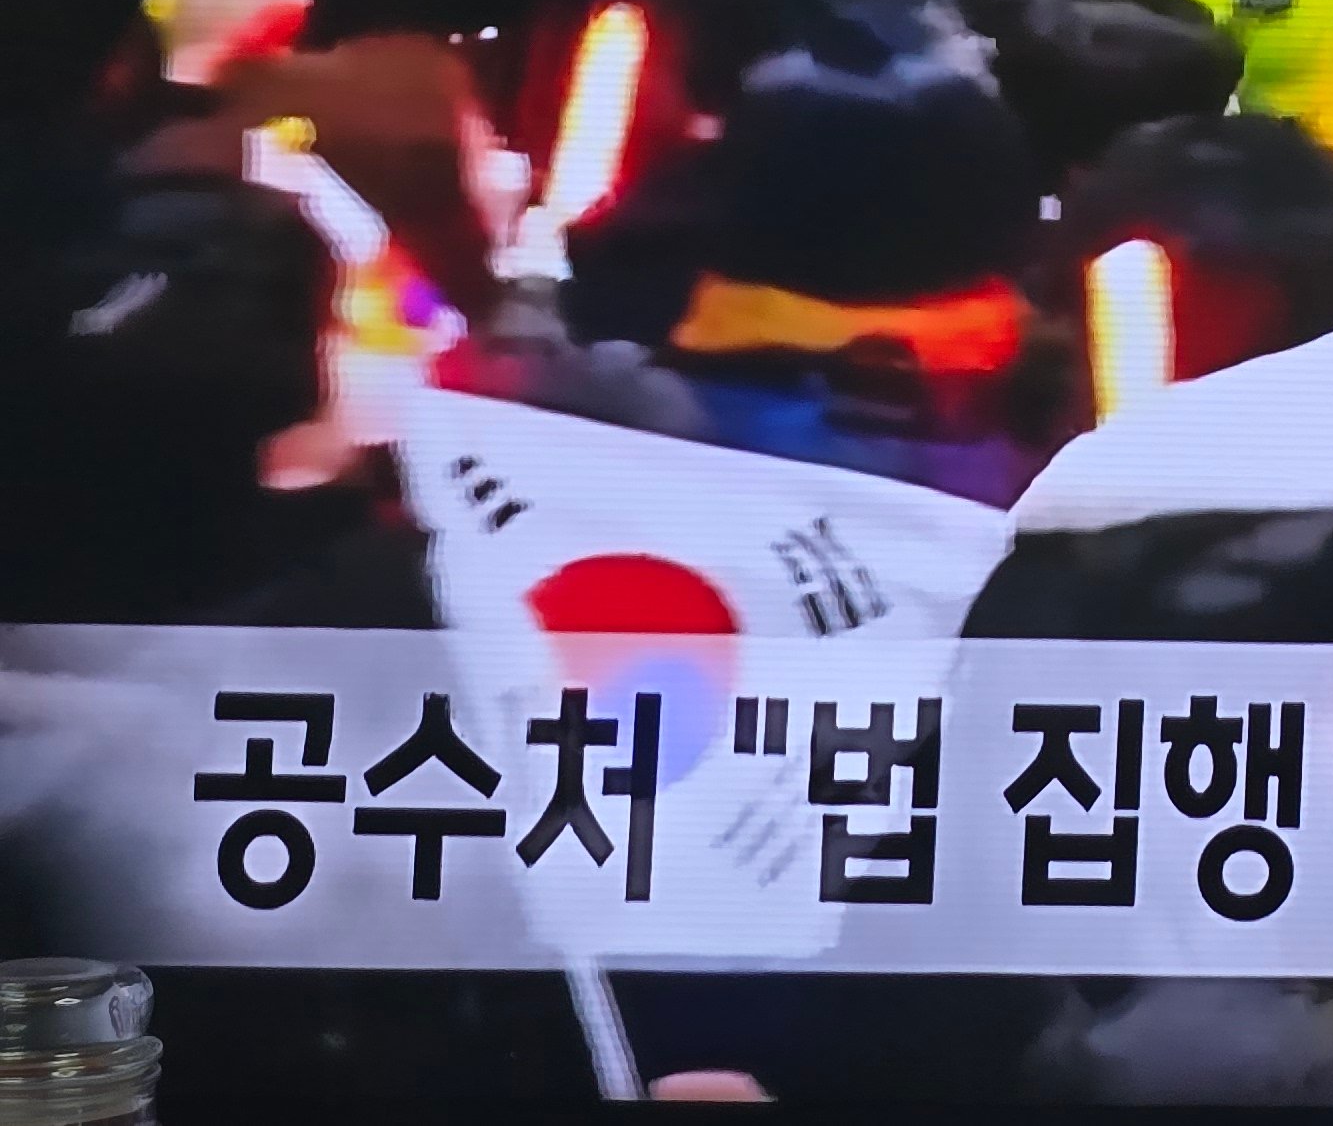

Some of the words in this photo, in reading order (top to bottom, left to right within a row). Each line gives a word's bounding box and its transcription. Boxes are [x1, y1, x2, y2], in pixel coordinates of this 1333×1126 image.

[193, 688, 662, 910] 공수처
[733, 696, 943, 906] "법
[1003, 695, 1306, 922] 집행
